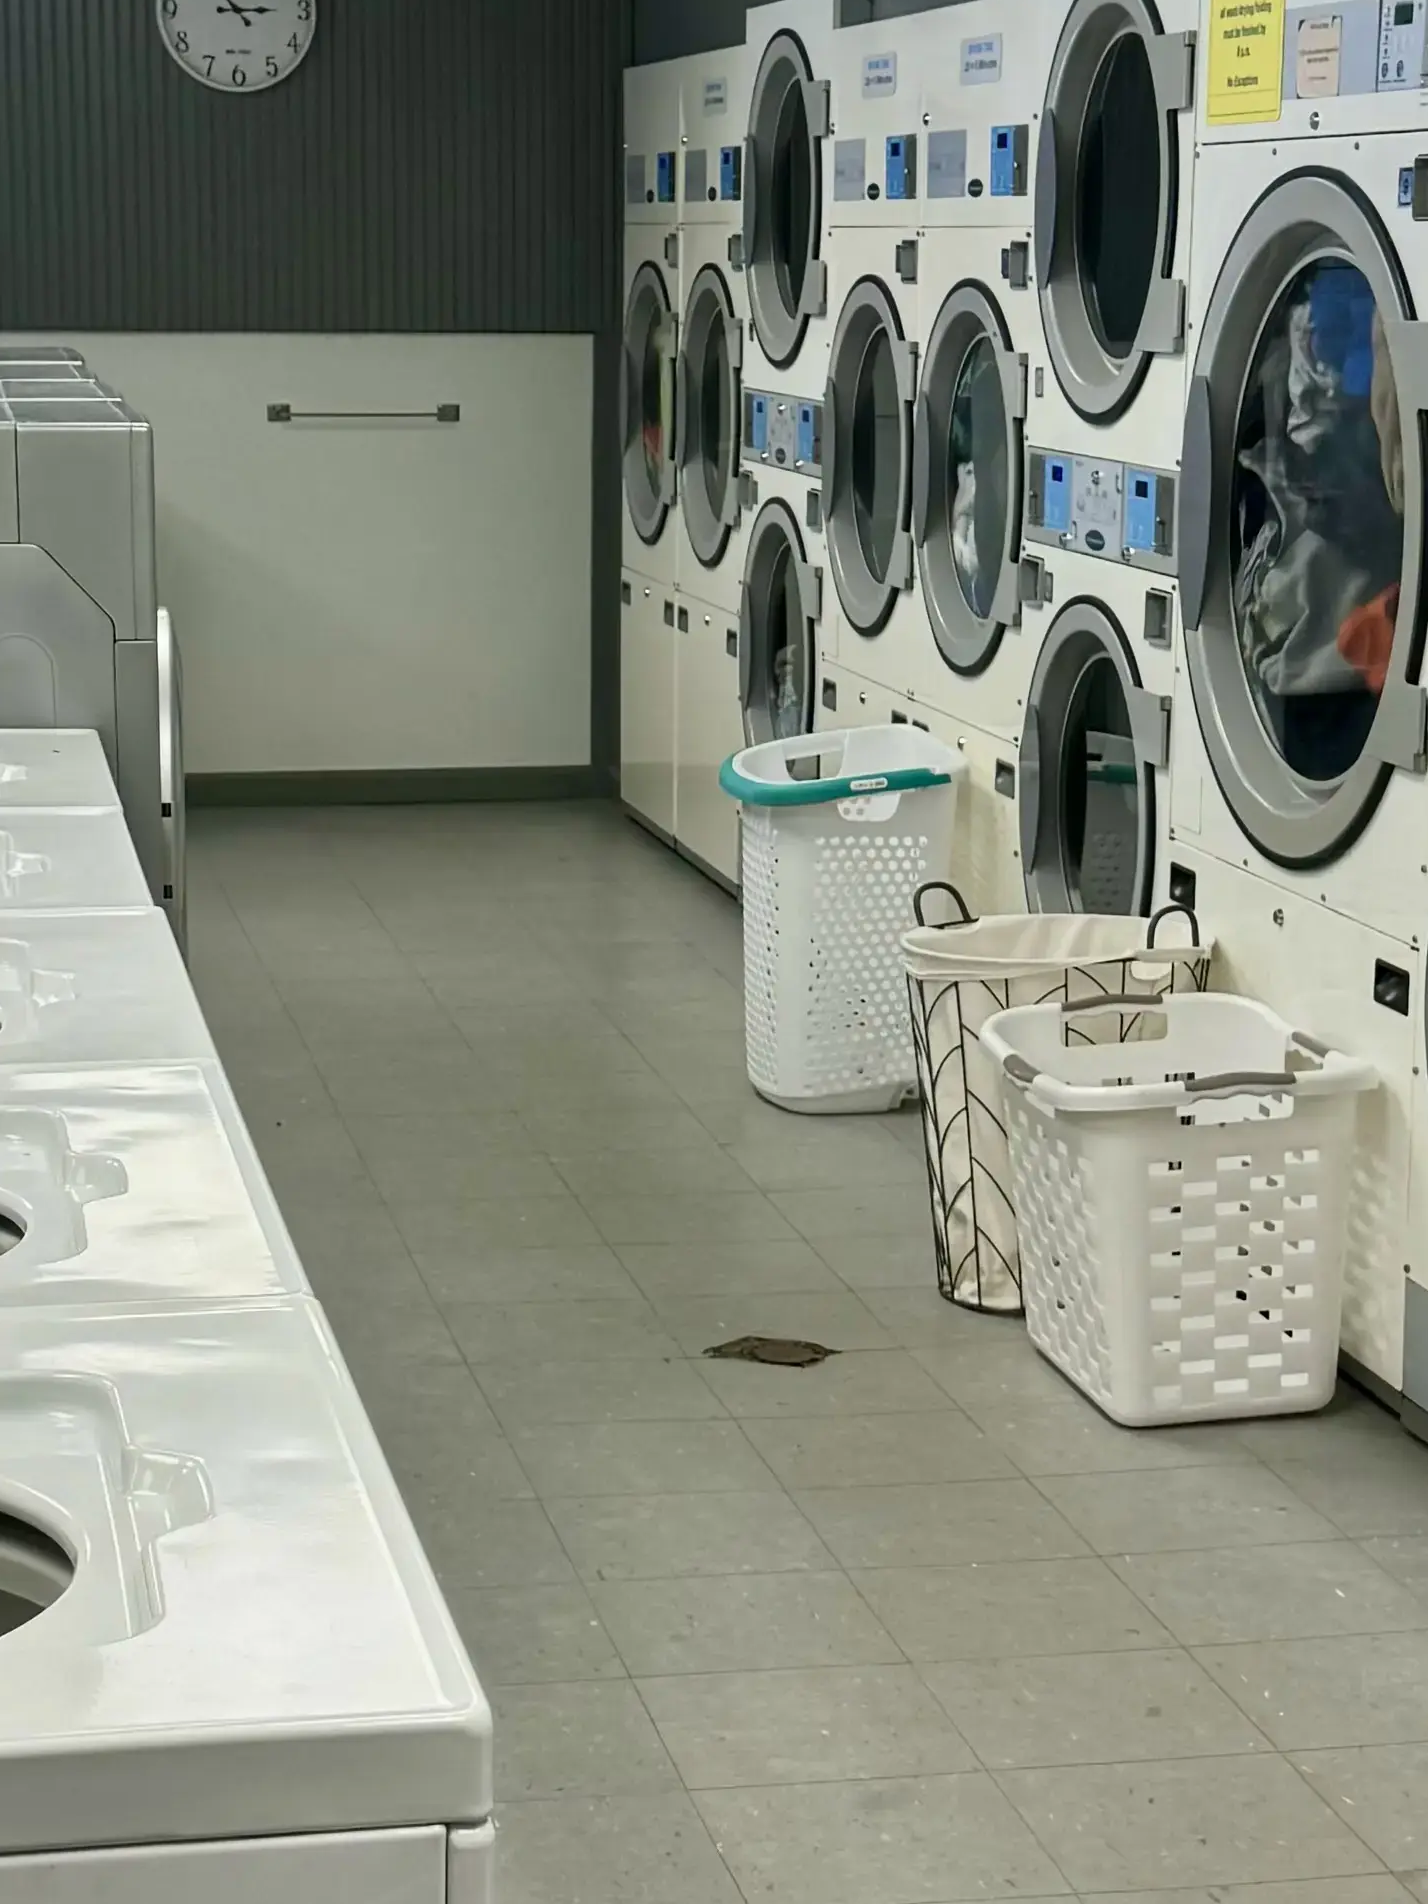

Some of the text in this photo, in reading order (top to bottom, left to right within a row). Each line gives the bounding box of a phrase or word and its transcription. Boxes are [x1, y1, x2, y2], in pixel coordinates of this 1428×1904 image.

[297, 0, 311, 21] 3
[175, 31, 189, 53] 8
[286, 32, 301, 54] 4
[202, 55, 216, 77] 7
[232, 64, 246, 86] 6
[265, 56, 279, 77] 5
